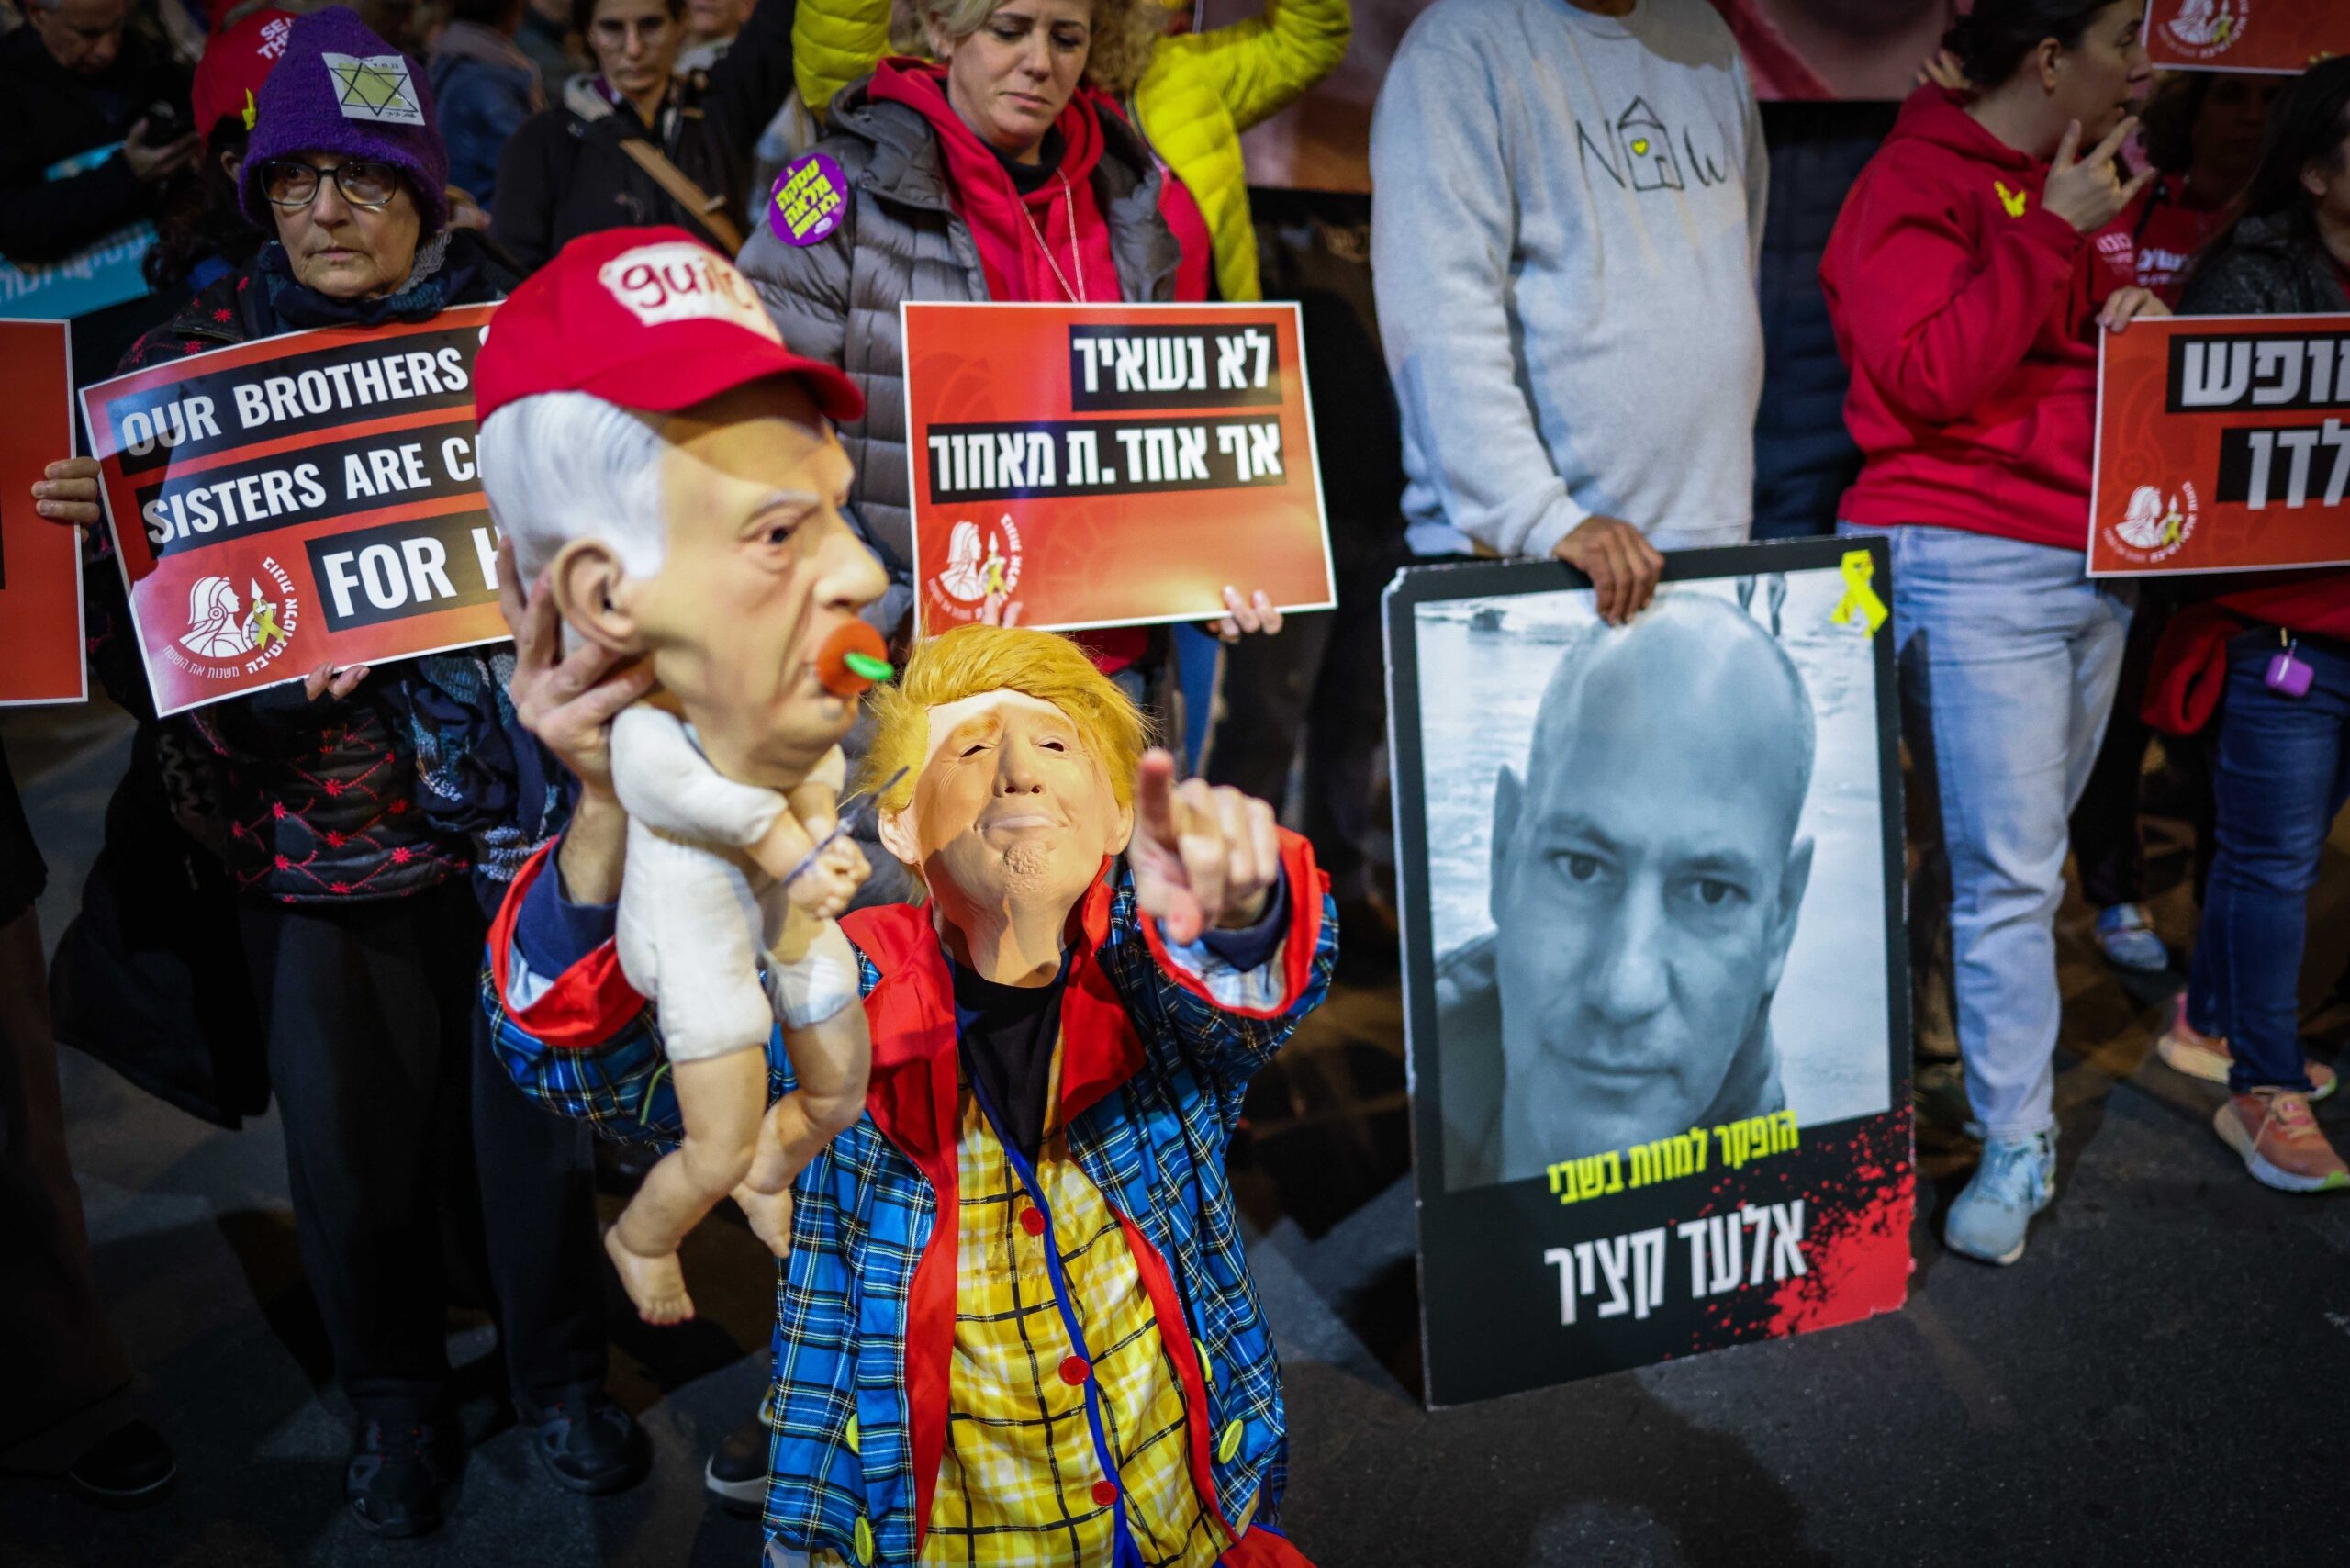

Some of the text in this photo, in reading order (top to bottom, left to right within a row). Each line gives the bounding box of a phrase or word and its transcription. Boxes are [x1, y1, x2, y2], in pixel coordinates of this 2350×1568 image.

[783, 174, 833, 228] מלאה
[1073, 329, 1271, 393] לא נשאיר
[2181, 339, 2350, 407] ופש
[122, 347, 469, 457] OUR BROTHERS
[142, 434, 483, 544] SISTERS ARE C
[928, 423, 1282, 491] אף אחד.ת מאחור
[262, 556, 295, 594] בונות
[322, 536, 457, 618] FOR
[189, 663, 206, 677] את
[207, 666, 240, 679] משנות
[1547, 1109, 1799, 1205] הופקר למוות בשבי
[1544, 1198, 1807, 1326] אלעד קציר
